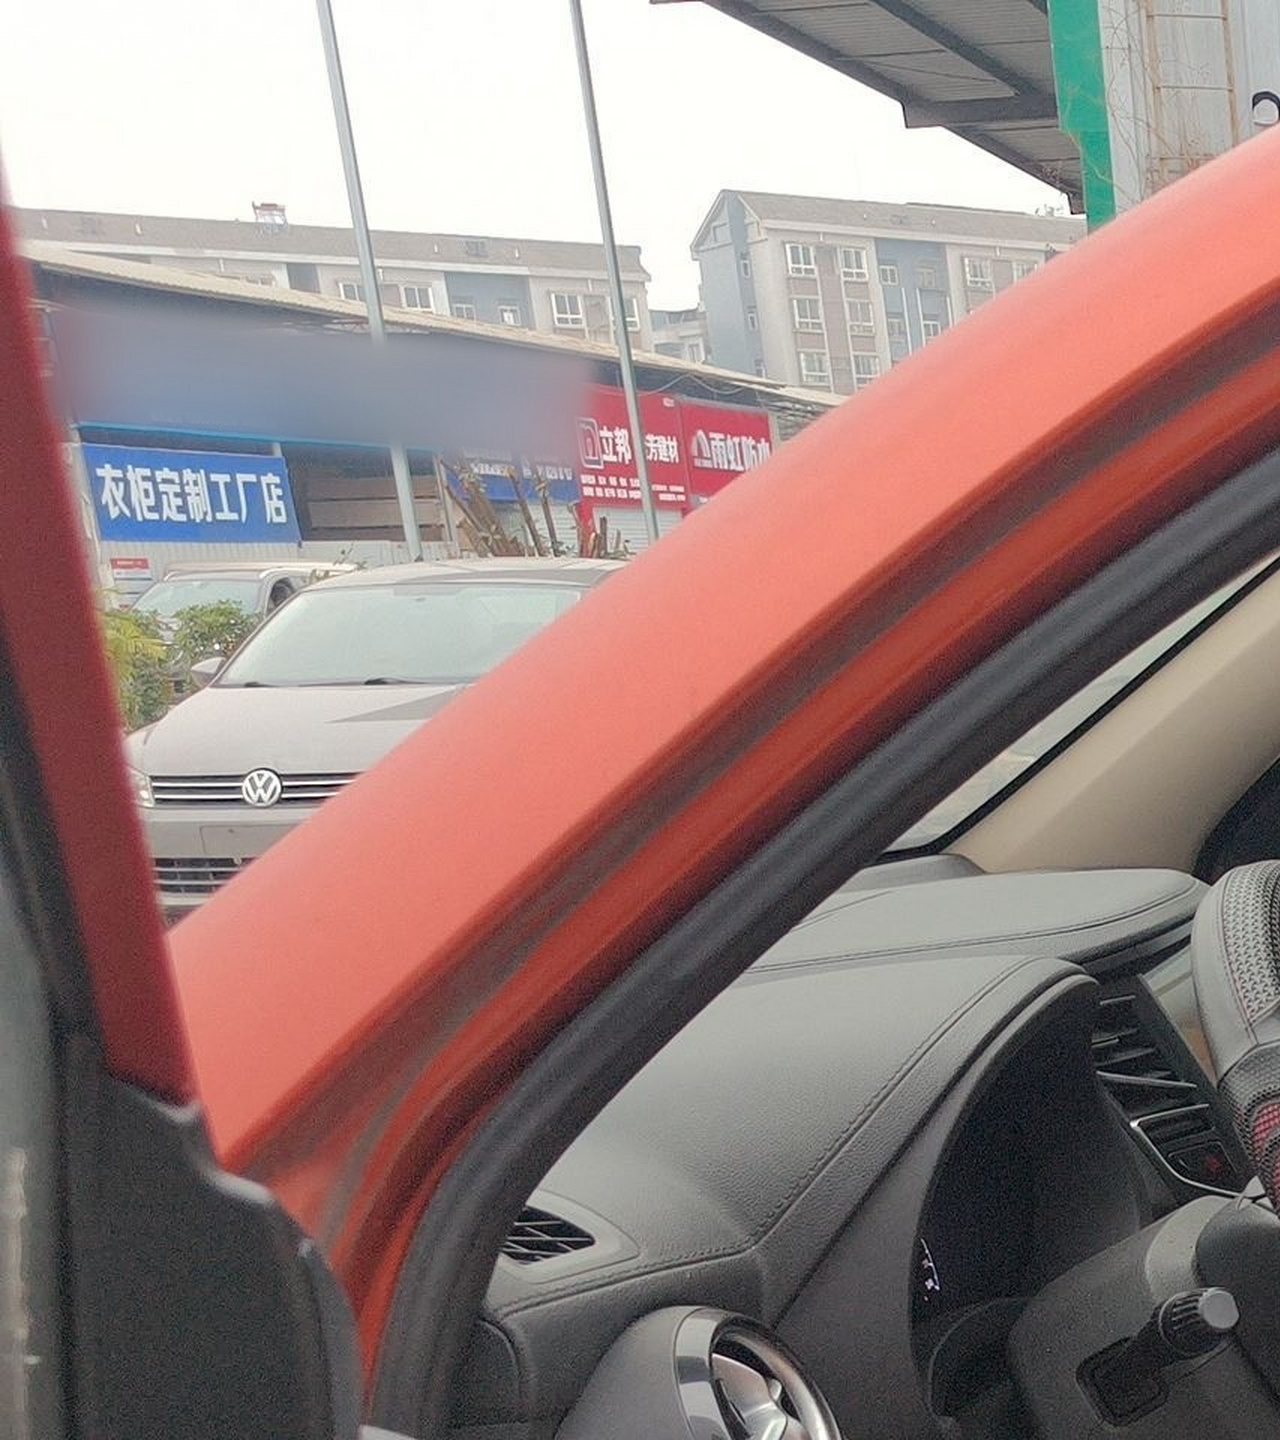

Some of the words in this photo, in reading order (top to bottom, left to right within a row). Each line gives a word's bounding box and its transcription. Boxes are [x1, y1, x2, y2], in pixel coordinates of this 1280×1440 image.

[599, 426, 632, 465] 立邦
[95, 463, 288, 525] 衣柜定制工厂店
